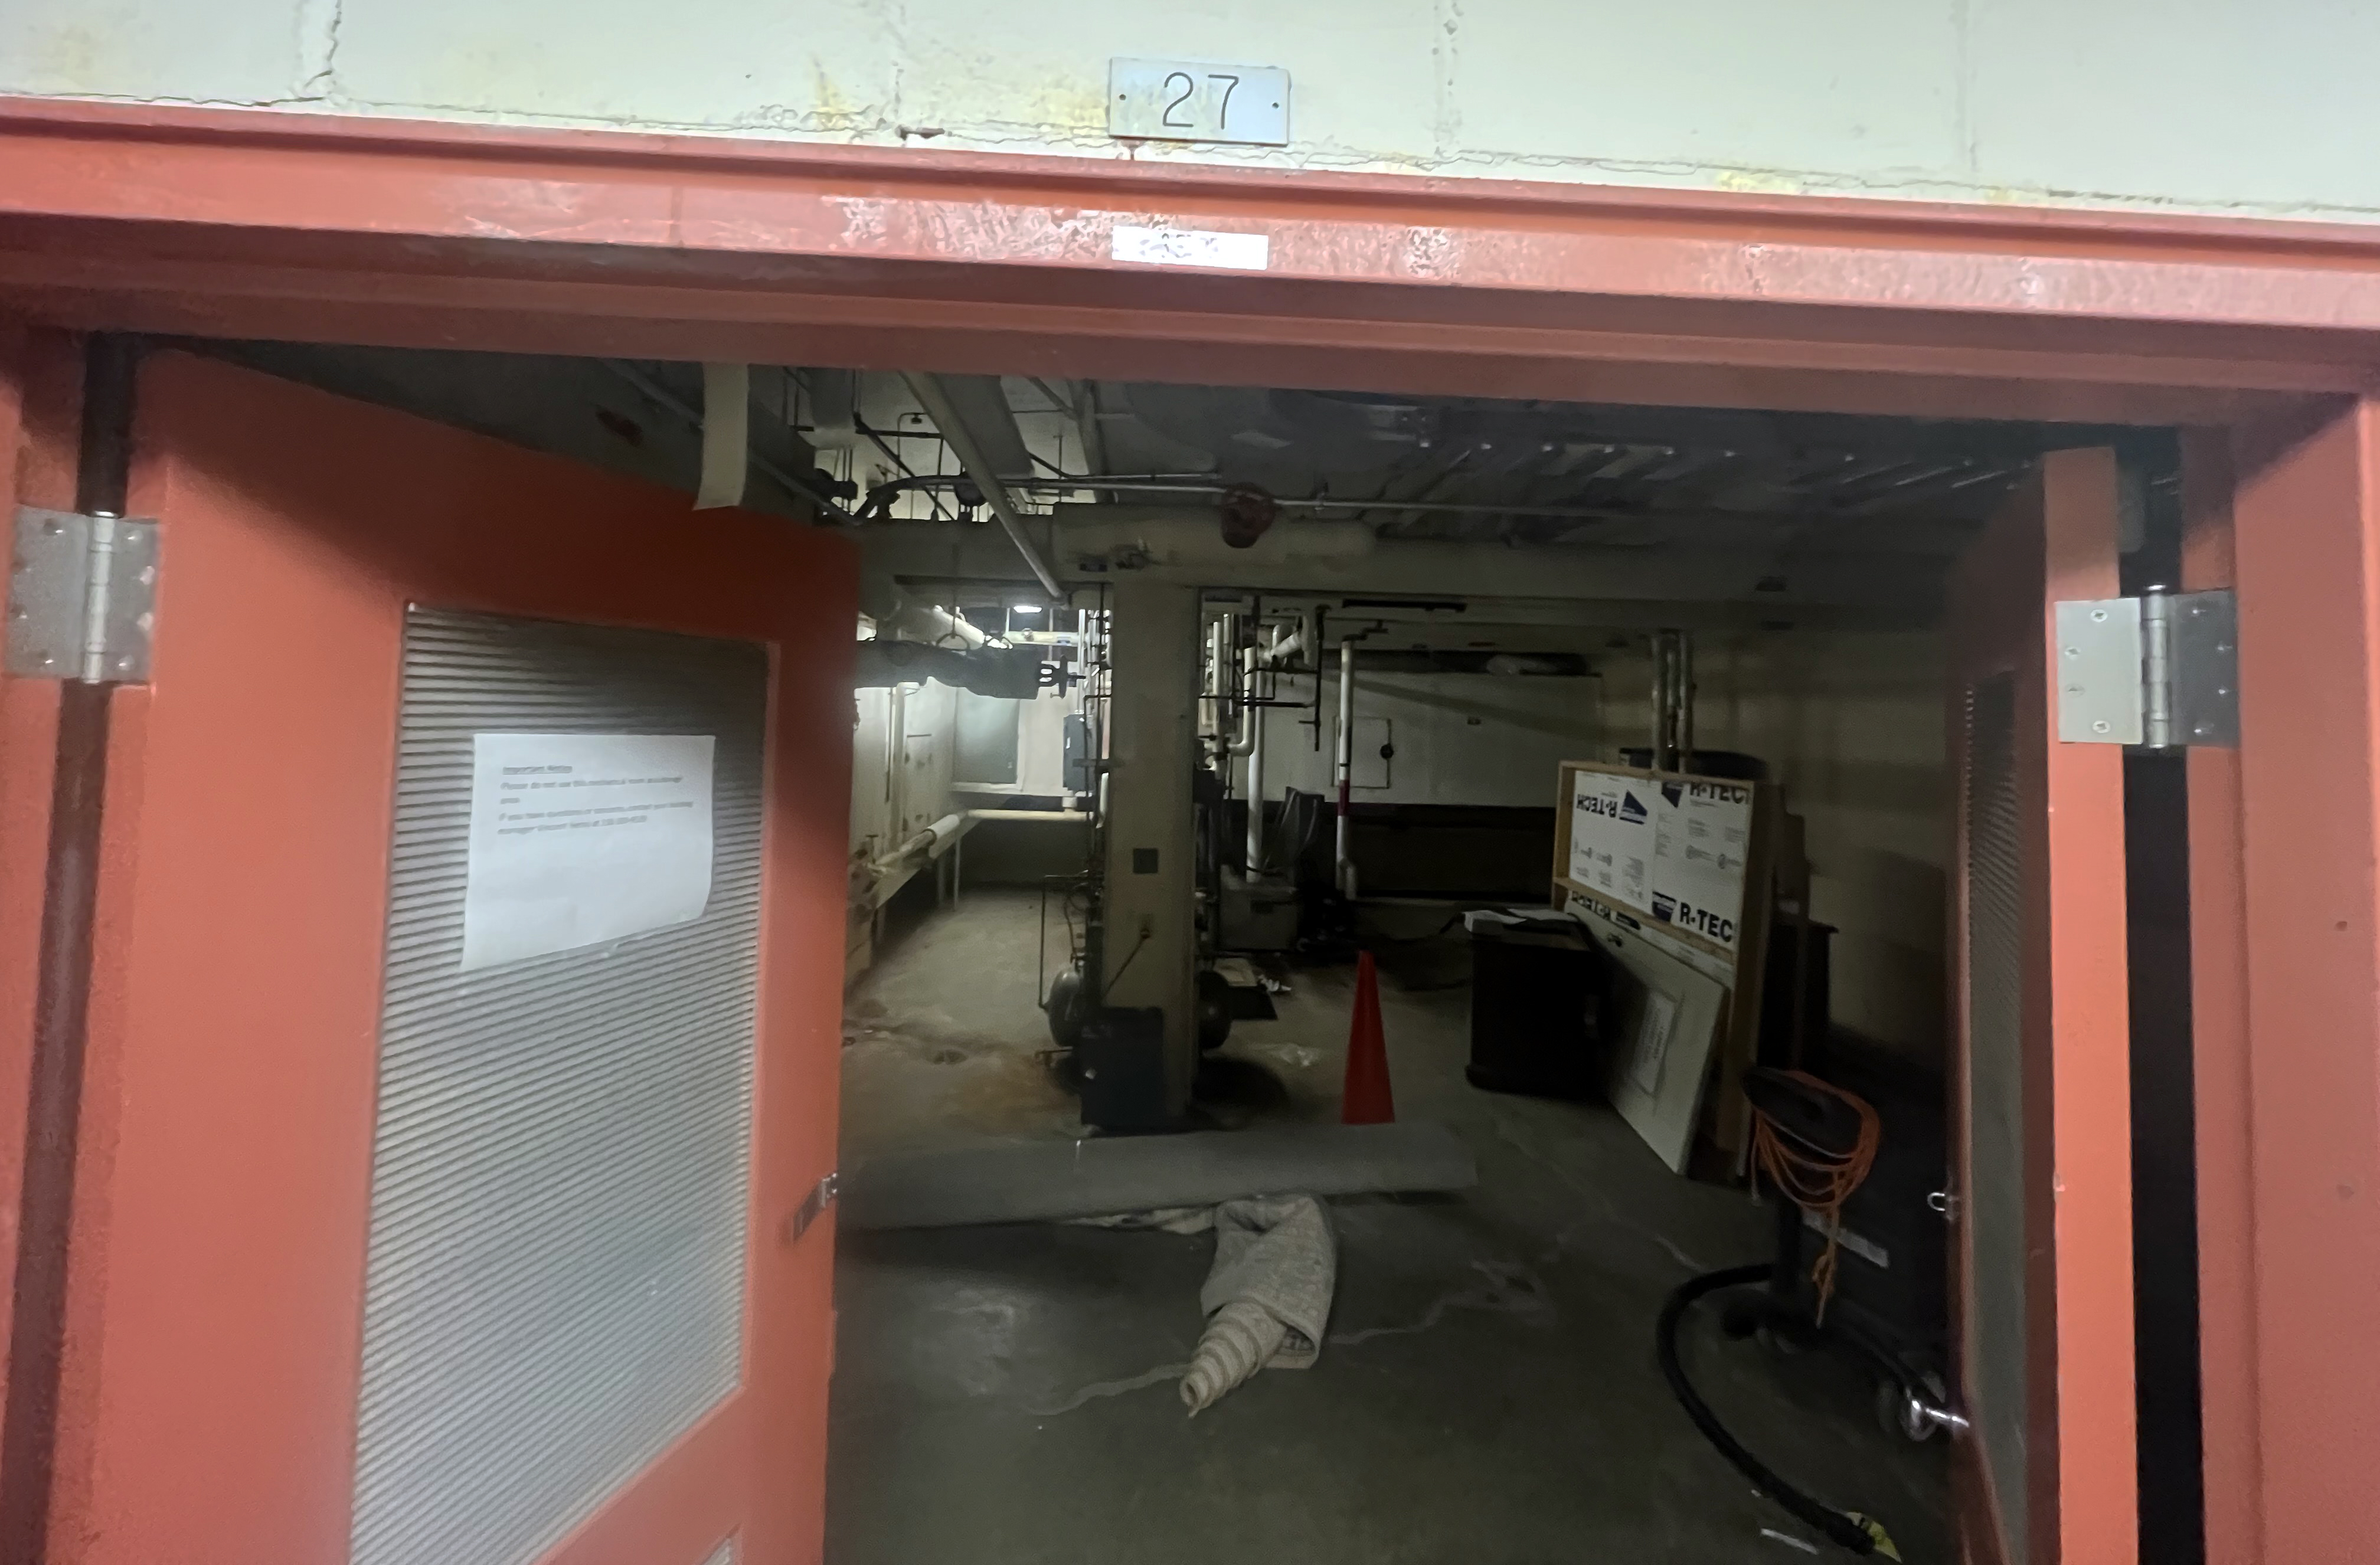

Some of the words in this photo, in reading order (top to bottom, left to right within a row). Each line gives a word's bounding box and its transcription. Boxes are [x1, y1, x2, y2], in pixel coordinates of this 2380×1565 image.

[1162, 71, 1240, 130] 27
[1690, 782, 1746, 804] R-TEC
[1679, 902, 1734, 942] R-TEC
